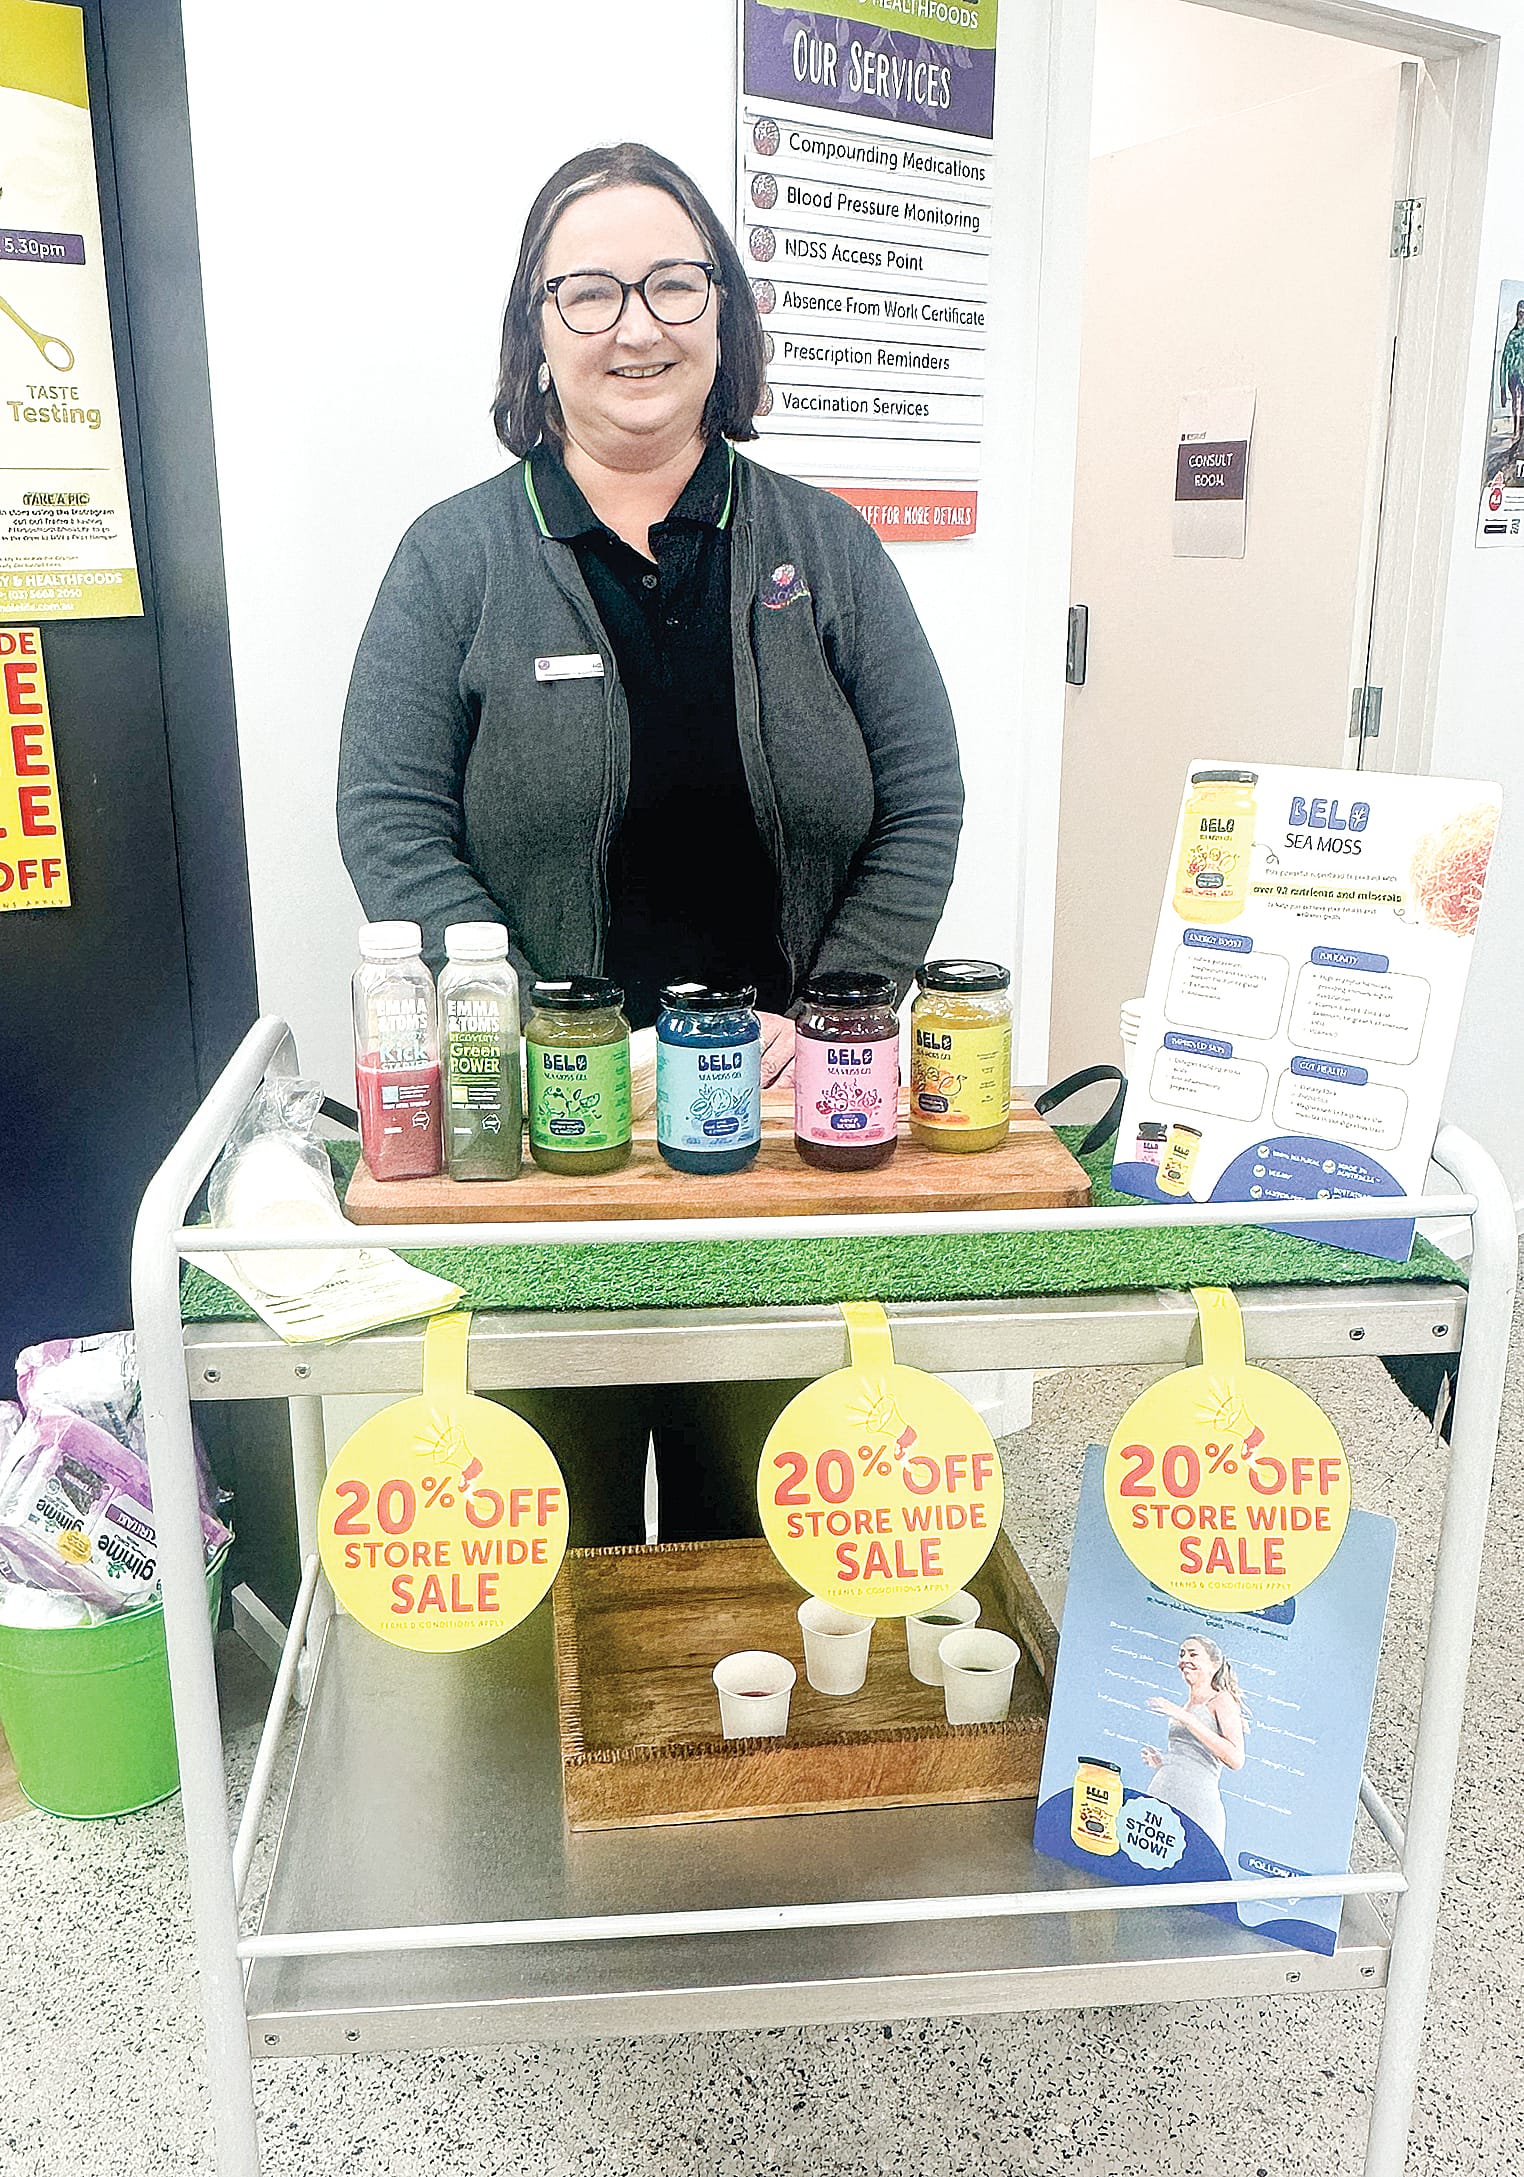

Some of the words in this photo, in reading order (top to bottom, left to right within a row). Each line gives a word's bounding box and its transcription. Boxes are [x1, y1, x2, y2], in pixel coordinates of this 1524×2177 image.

[792, 29, 838, 88] OUR
[849, 40, 951, 109] SERVICES
[789, 132, 899, 170] Compounding
[903, 152, 986, 181] Medications
[787, 186, 832, 209] Blood
[837, 194, 900, 218] Pressure
[904, 202, 980, 233] Monitoring
[3, 237, 66, 260] 5.30pm
[785, 238, 827, 260] NDSS
[831, 244, 882, 267] Access
[887, 251, 924, 272] Point
[782, 290, 843, 313] Absence
[846, 296, 881, 317] From
[884, 301, 918, 321] Work
[921, 305, 986, 328] Certificate
[783, 341, 872, 367] Prescription
[877, 348, 950, 371] Reminders
[26, 384, 80, 401] TASTE
[782, 391, 869, 413] Vaccination
[872, 397, 930, 417] Services
[7, 400, 102, 430] Testing
[1188, 453, 1234, 468] CONSULT
[1194, 473, 1225, 487] ROOM
[854, 505, 881, 525] AFF
[881, 505, 900, 525] FOR
[903, 506, 931, 525] MORE
[25, 573, 123, 587] HEALTHFOODS
[1289, 796, 1371, 832] BELO
[1284, 832, 1313, 850] SEA
[1317, 836, 1363, 856] MOSS
[1253, 886, 1273, 896] over
[1336, 888, 1355, 900] and
[376, 998, 427, 1016] EMMA
[449, 1000, 499, 1017] EMMA
[380, 1041, 428, 1062] Kick
[450, 1042, 500, 1058] Green
[543, 1052, 588, 1071] BELO
[698, 1052, 742, 1071] BELO
[828, 1048, 873, 1066] BELO
[450, 1058, 500, 1074] POWER
[773, 1445, 892, 1506] 20%
[903, 1452, 994, 1494] OFF
[1119, 1443, 1238, 1498] 20%
[1249, 1456, 1341, 1495] OFF
[334, 1476, 455, 1536] 20%
[465, 1487, 561, 1528] OFF
[1132, 1503, 1237, 1530] STORE
[1247, 1506, 1331, 1531] WIDE
[787, 1508, 893, 1538] STORE
[902, 1503, 987, 1532] WIDE
[97, 1534, 158, 1582] gimme
[345, 1540, 451, 1569] STORE
[461, 1538, 549, 1566] WIDE
[836, 1538, 944, 1581] SALE
[1180, 1536, 1286, 1575] SALE
[390, 1573, 500, 1615] SALE
[1144, 1809, 1163, 1825] IN
[1126, 1817, 1176, 1848] STORE
[1127, 1831, 1168, 1858] NOW!
[1248, 1858, 1290, 1879] FOLLOW
